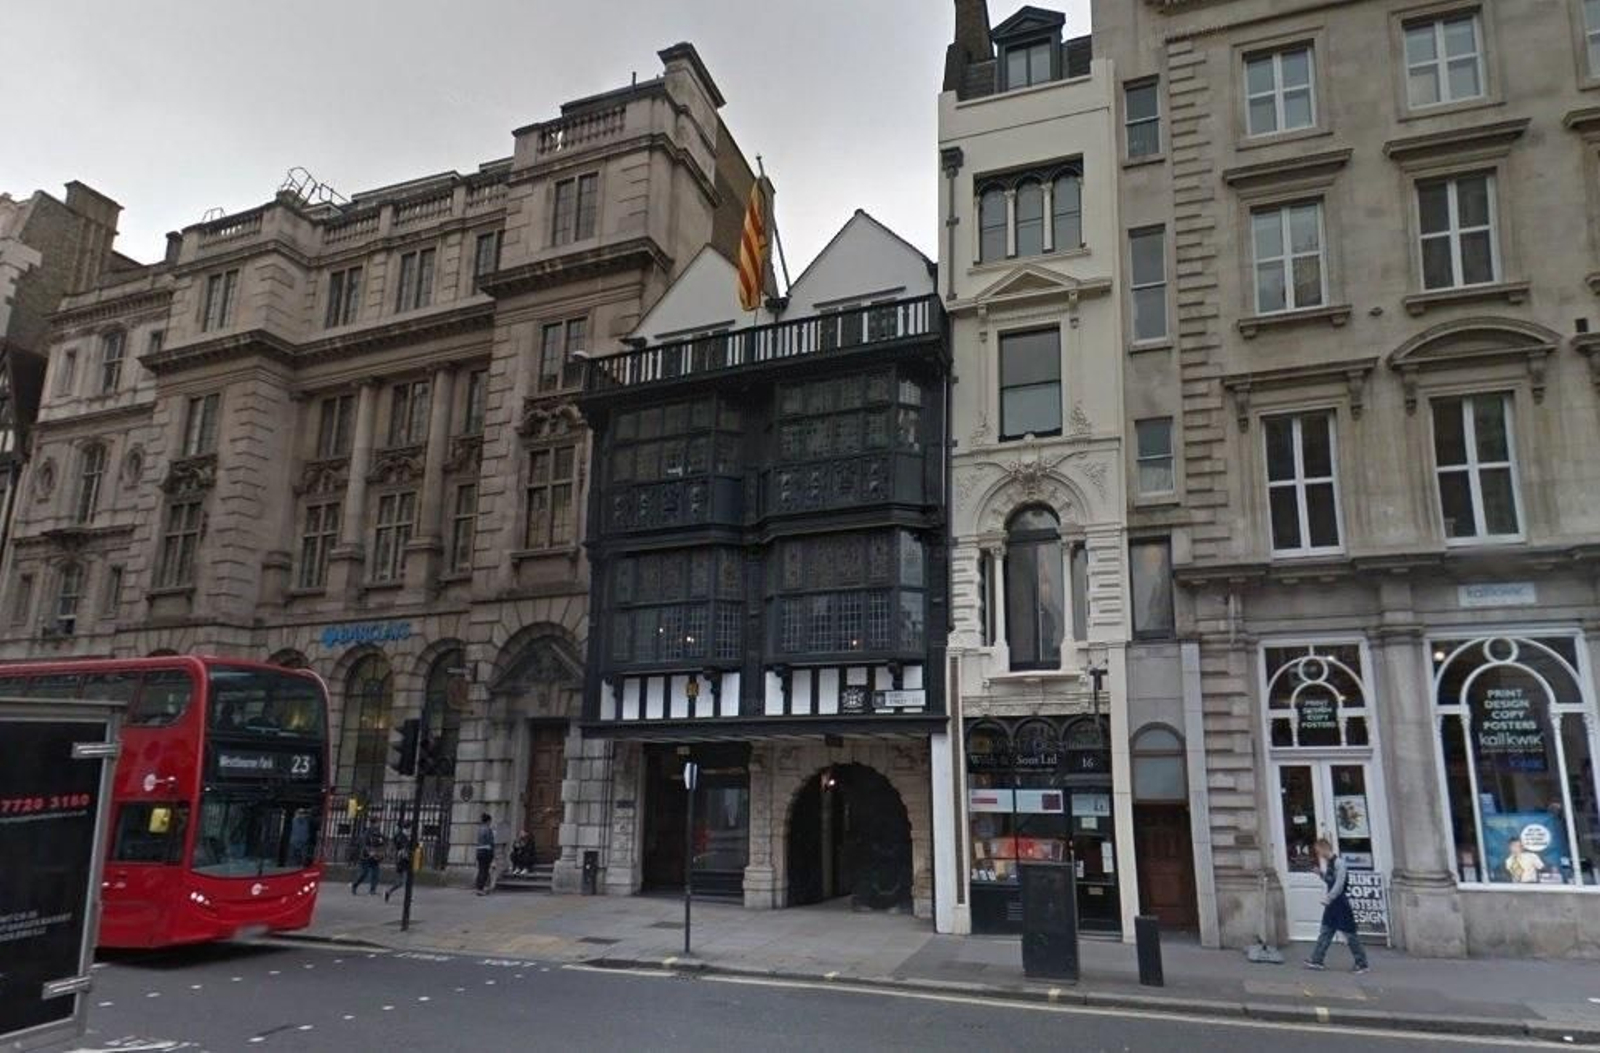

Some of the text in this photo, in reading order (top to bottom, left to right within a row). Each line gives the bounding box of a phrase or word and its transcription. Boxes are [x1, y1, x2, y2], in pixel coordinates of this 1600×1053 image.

[1487, 689, 1523, 699] PRINT
[1484, 700, 1530, 709] DESIGN
[1491, 710, 1525, 719] COPY
[1301, 721, 1336, 729] POSTERS
[1482, 721, 1537, 731] POSTERS
[291, 754, 311, 773] 23
[1040, 753, 1058, 765] Ltd
[1082, 757, 1094, 768] 16
[1296, 844, 1310, 855] 14
